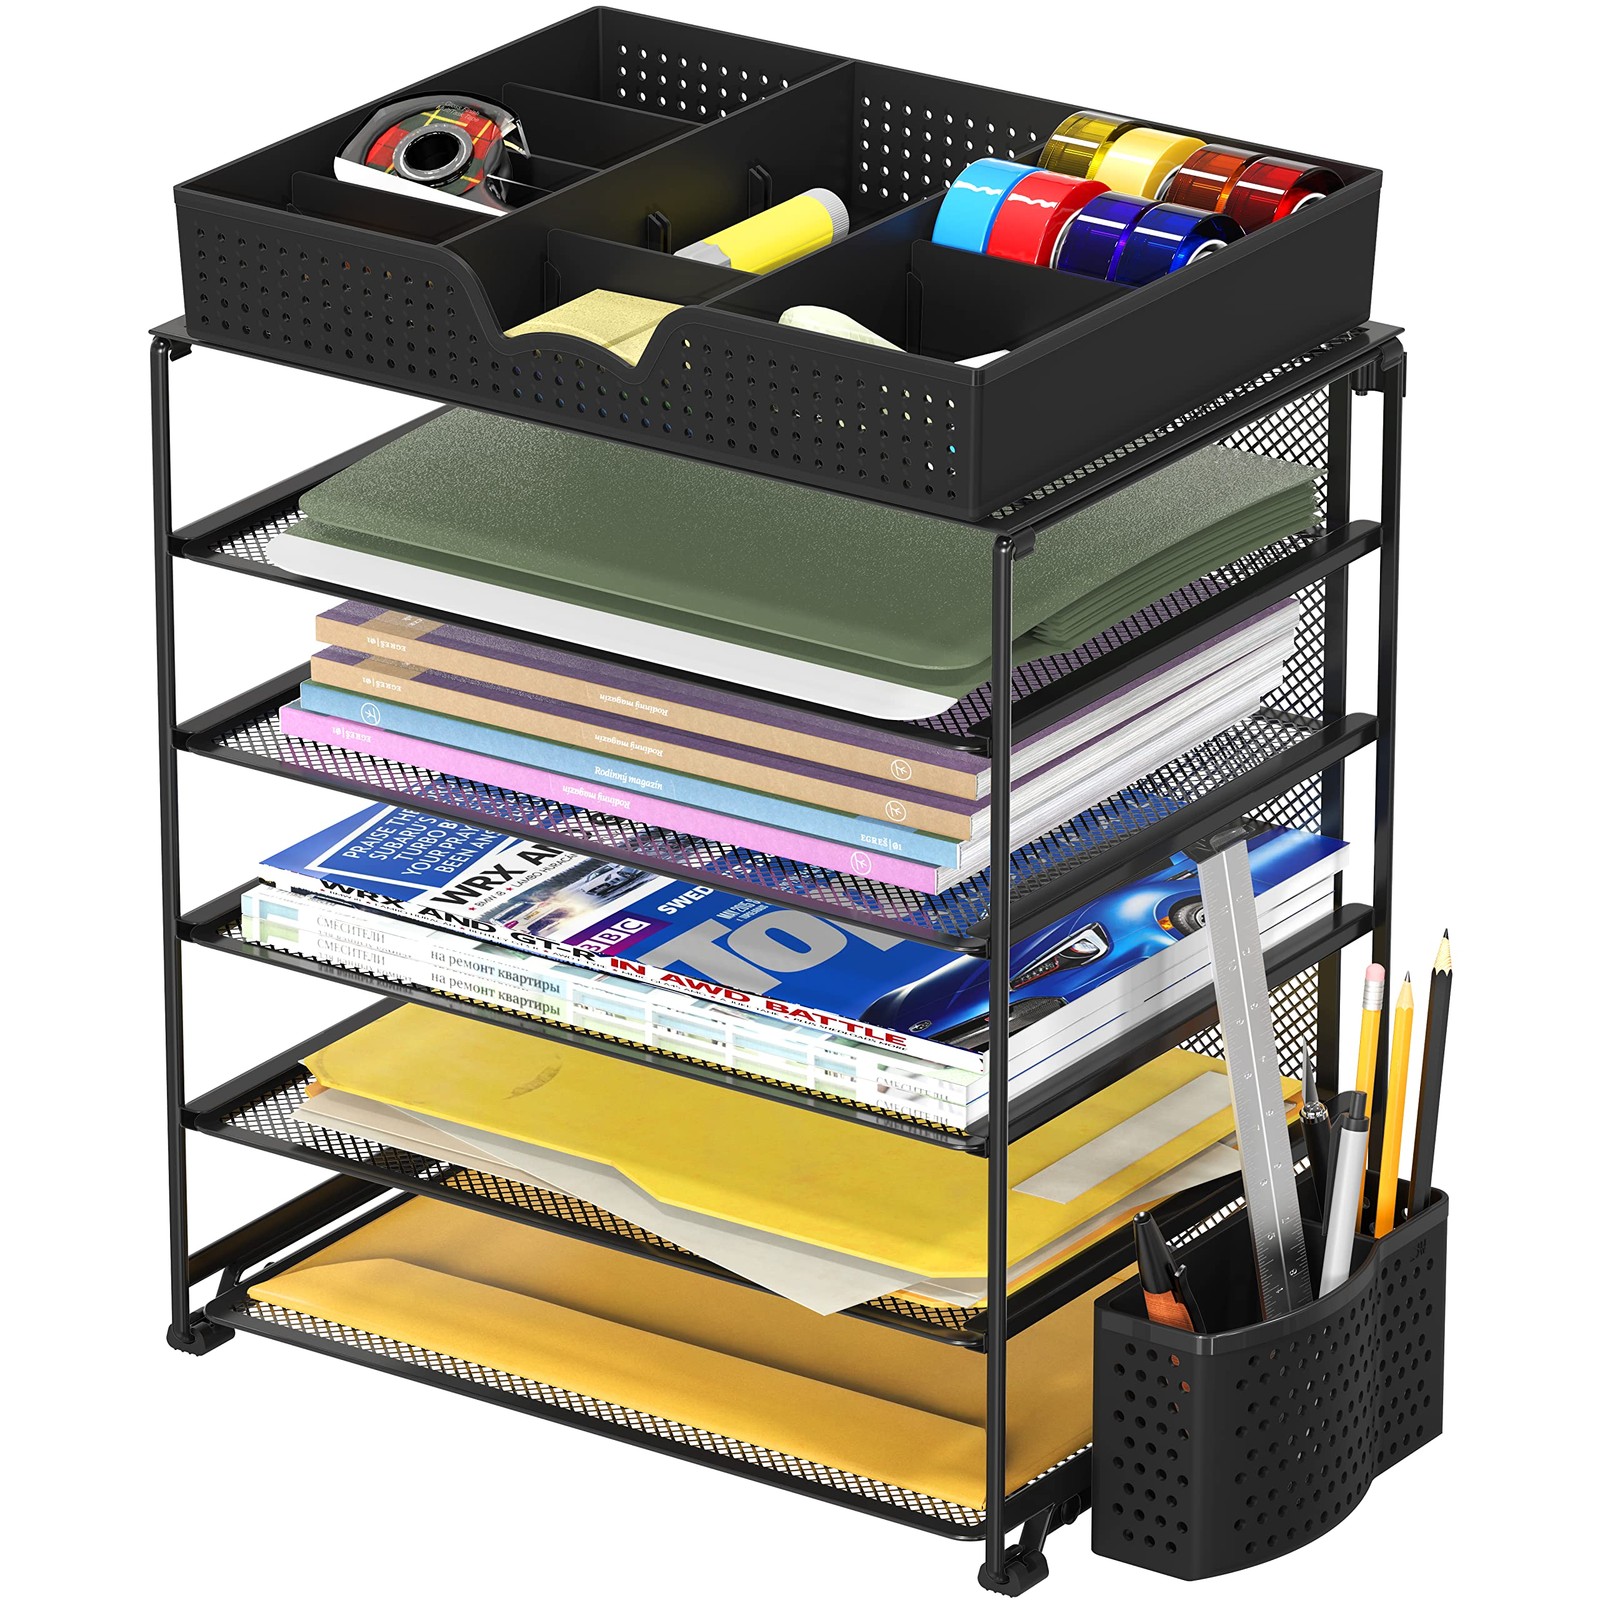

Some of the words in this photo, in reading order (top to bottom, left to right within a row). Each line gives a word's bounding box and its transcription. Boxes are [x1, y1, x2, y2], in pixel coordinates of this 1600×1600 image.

[594, 765, 628, 782] Rodinný
[628, 775, 663, 790] magazín
[342, 826, 398, 859] PRAISE
[384, 808, 420, 826] THE
[368, 816, 438, 861] SUBARU'S
[393, 829, 448, 861] TURBO
[401, 848, 450, 875] YOUR
[438, 824, 480, 850] PRAY
[434, 848, 479, 873] BEEN
[430, 863, 528, 905] WRX
[656, 885, 714, 915] SWED
[580, 918, 650, 952] BBC
[637, 909, 908, 995] TO
[320, 878, 405, 910] WRX
[418, 906, 497, 933] AND
[510, 932, 596, 961] GT-R
[611, 957, 646, 976] IN
[661, 973, 751, 1003] AWD
[765, 1000, 907, 1047] BATTLE
[430, 950, 446, 962] на
[448, 955, 496, 976] ремонт
[498, 969, 560, 994] квартиры
[431, 972, 446, 984] на
[449, 977, 496, 998] ремонт
[498, 991, 560, 1016] квартиры
